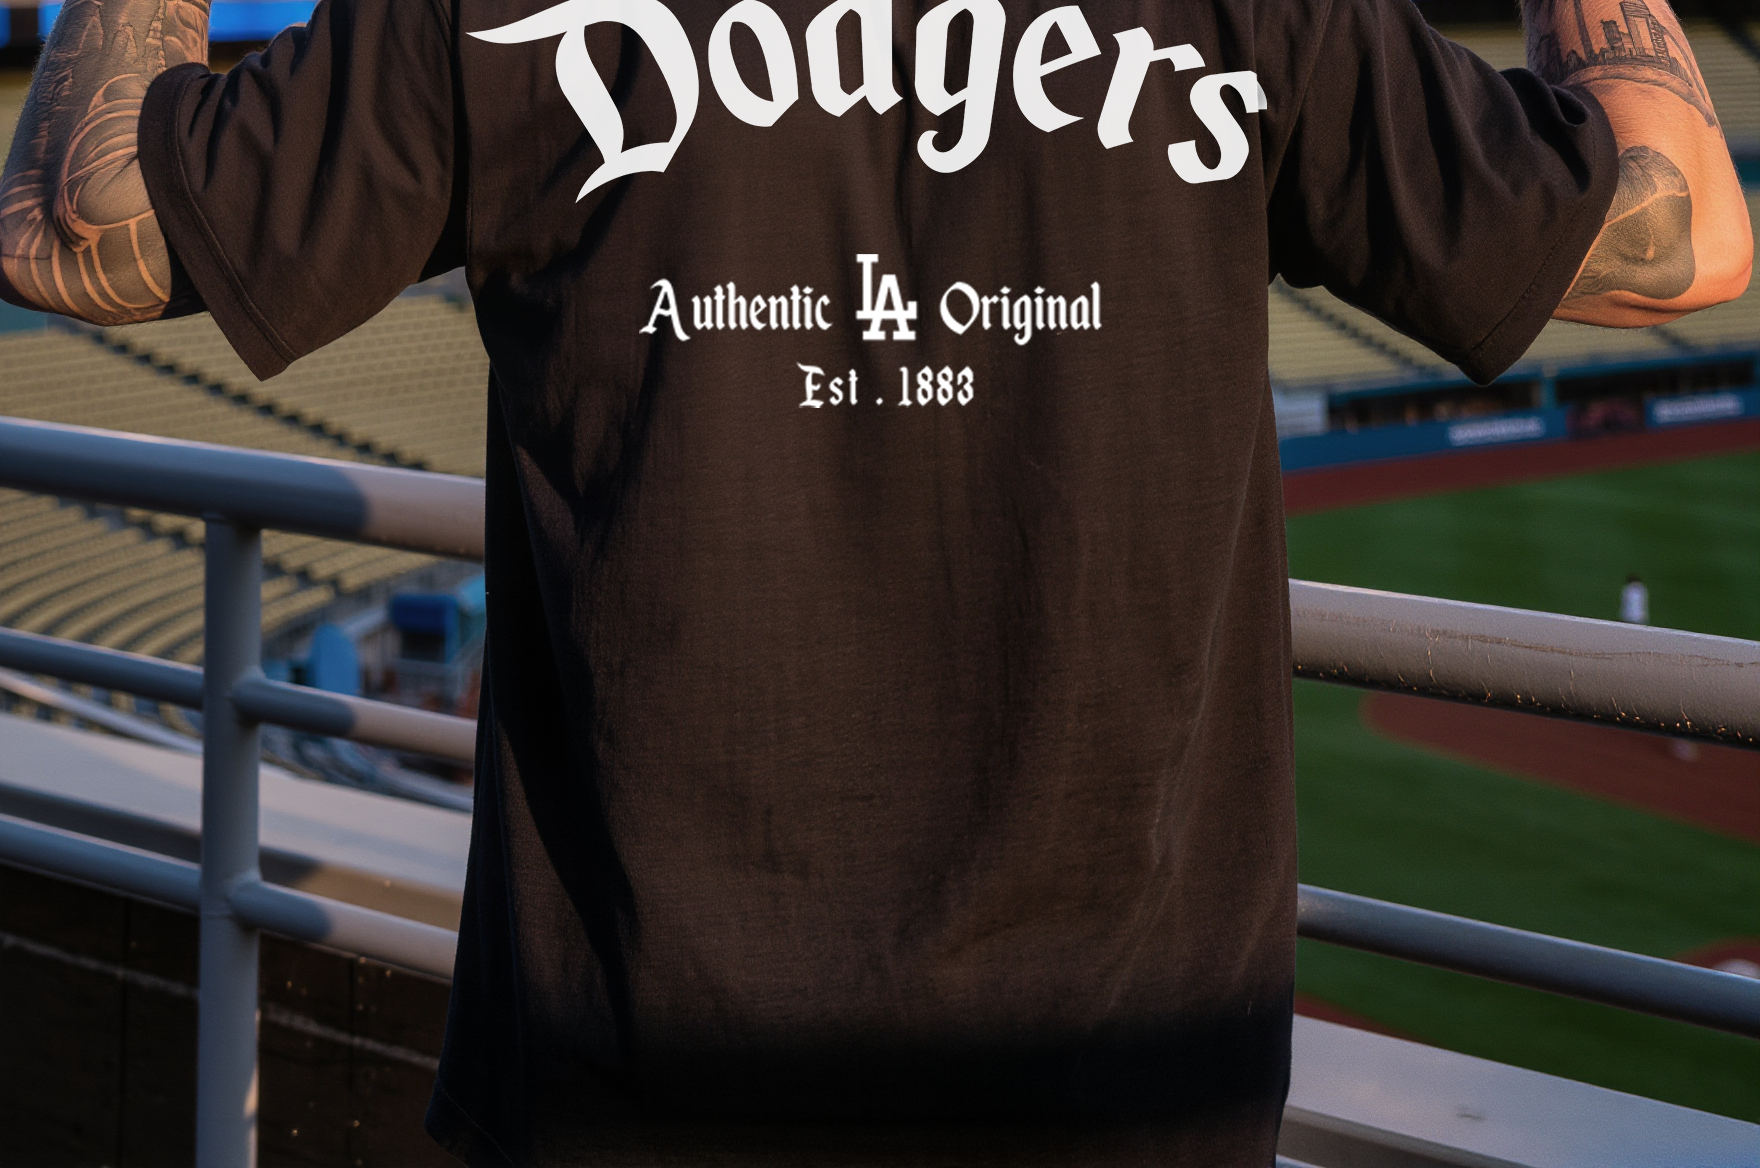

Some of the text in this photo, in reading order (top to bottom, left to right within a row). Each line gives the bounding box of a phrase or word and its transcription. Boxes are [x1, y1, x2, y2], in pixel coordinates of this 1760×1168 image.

[639, 253, 1102, 346] Authentic LA Original
[898, 365, 975, 407] 1883
